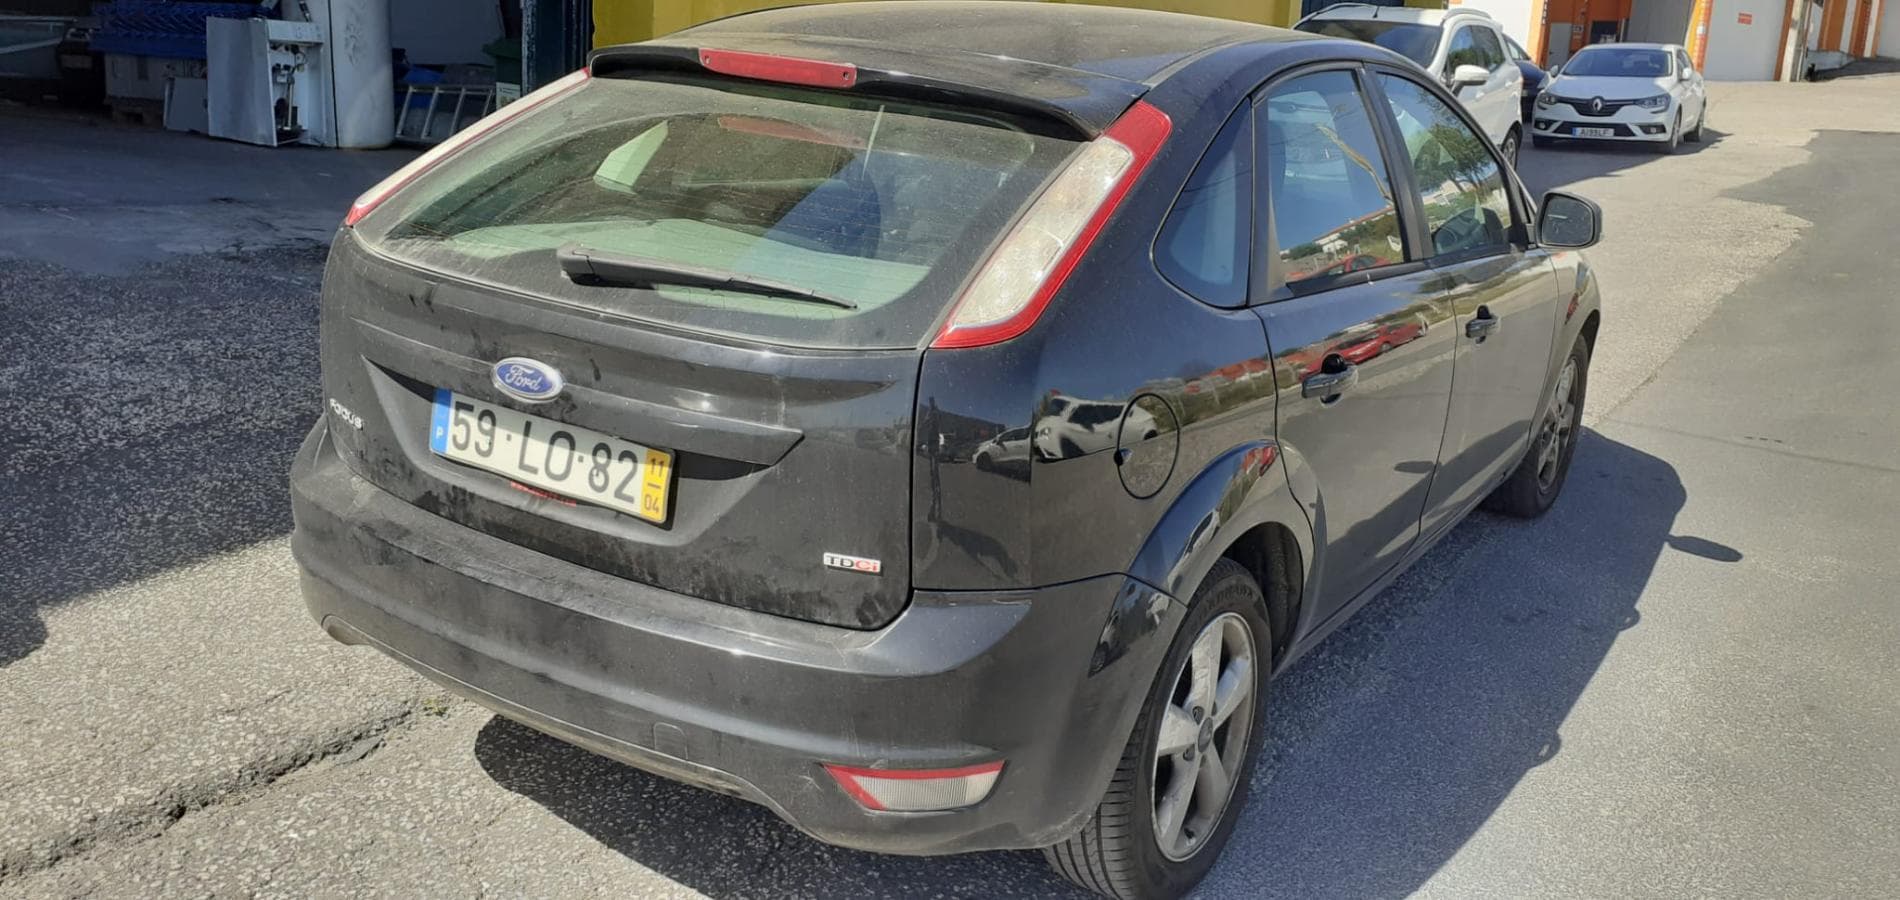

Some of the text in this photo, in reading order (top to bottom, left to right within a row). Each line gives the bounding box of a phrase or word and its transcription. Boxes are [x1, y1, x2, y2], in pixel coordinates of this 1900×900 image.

[505, 364, 543, 391] Ford
[436, 426, 444, 439] P
[650, 457, 665, 477] 11
[644, 493, 660, 514] 04
[825, 555, 879, 571] TDCi
